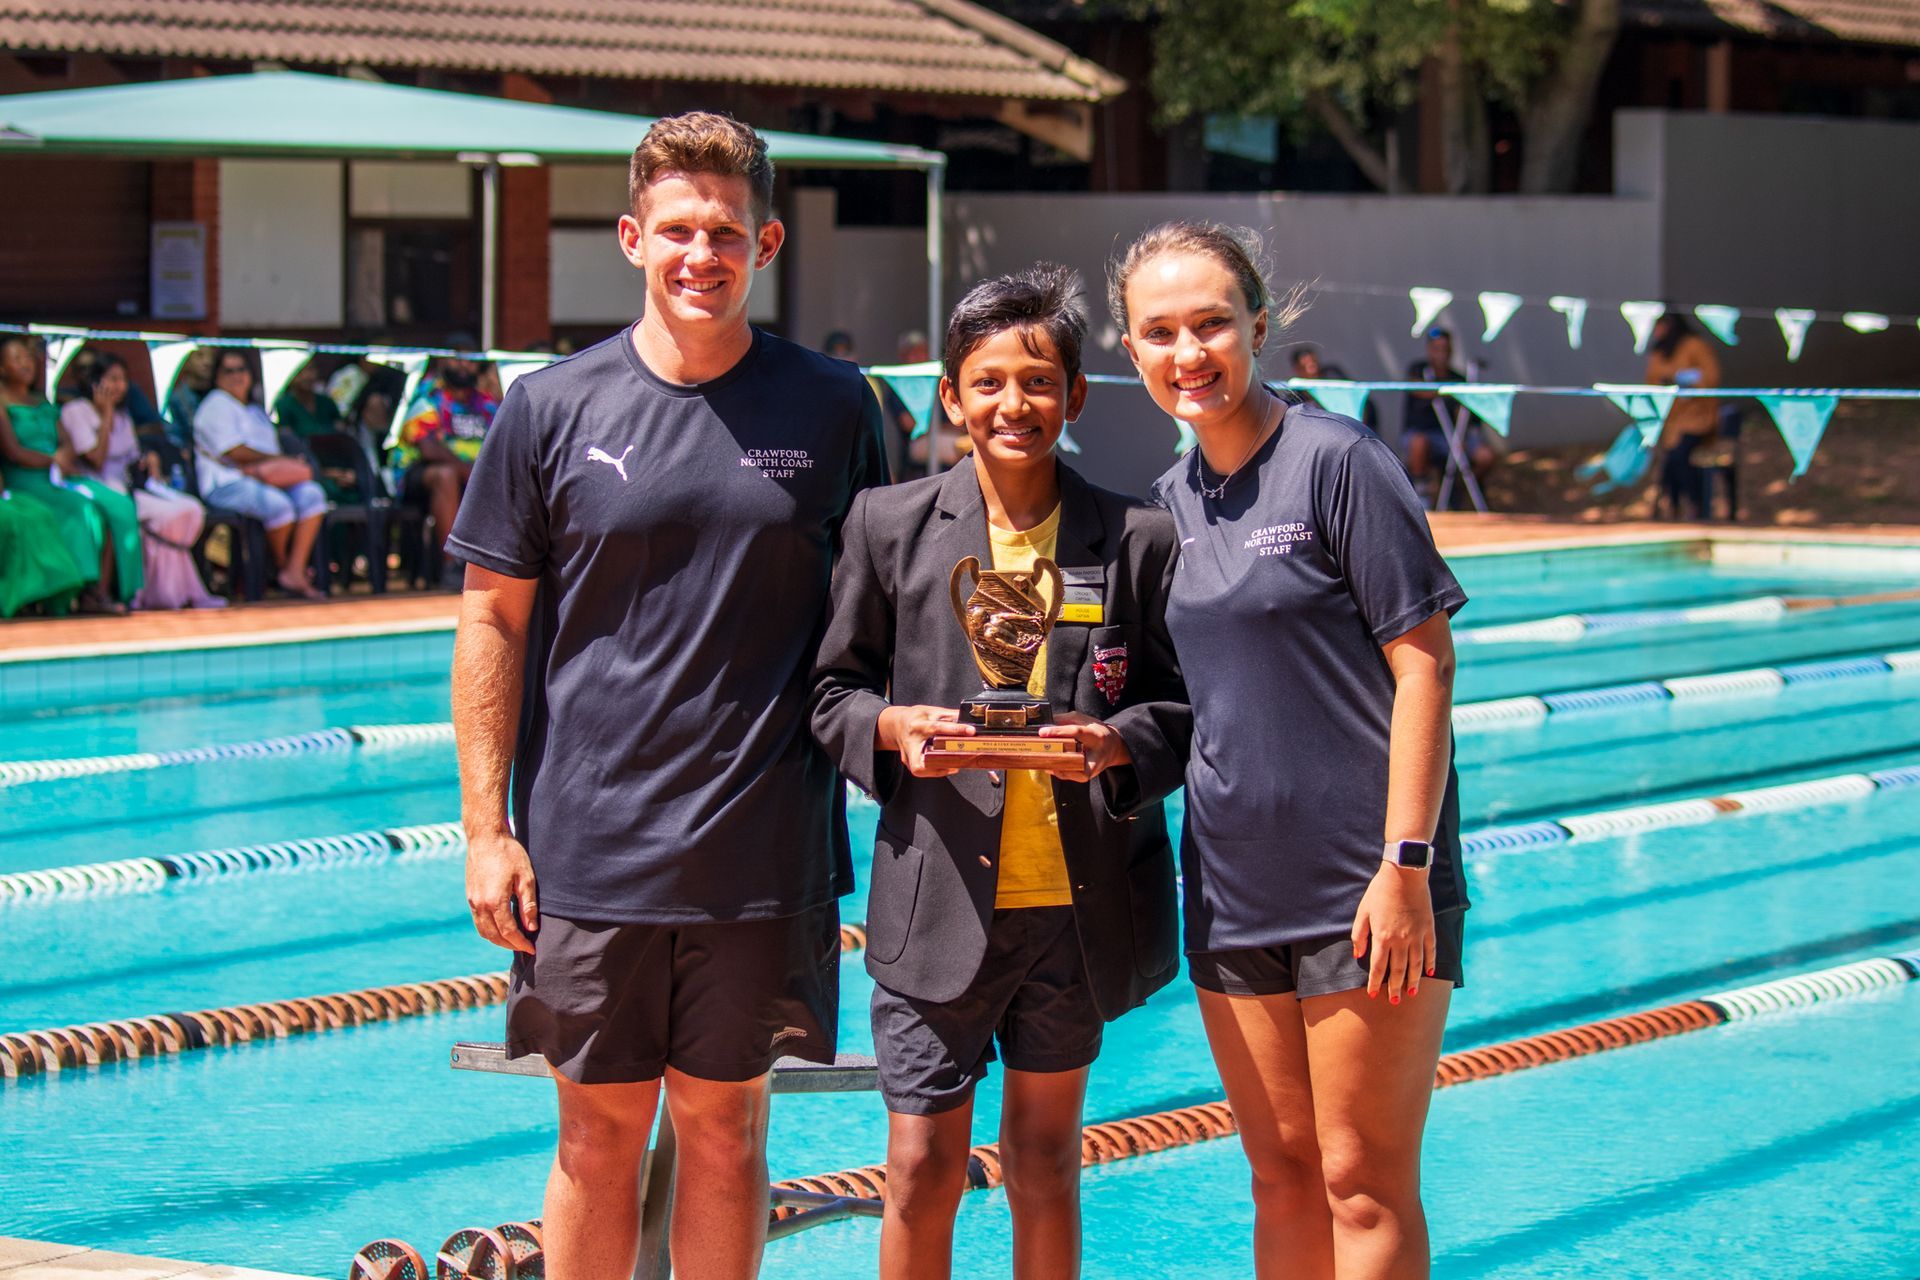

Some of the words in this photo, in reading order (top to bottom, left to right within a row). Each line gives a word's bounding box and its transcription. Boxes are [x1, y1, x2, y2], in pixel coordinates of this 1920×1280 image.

[747, 449, 807, 458] CRAWFORD
[740, 458, 778, 467] NORTH
[780, 458, 814, 468] COAST
[762, 469, 795, 478] STAFF
[1251, 522, 1305, 539] CRAWFORD
[1244, 535, 1275, 549] NORTH
[1277, 531, 1313, 543] COAST
[1259, 544, 1292, 556] STAFF
